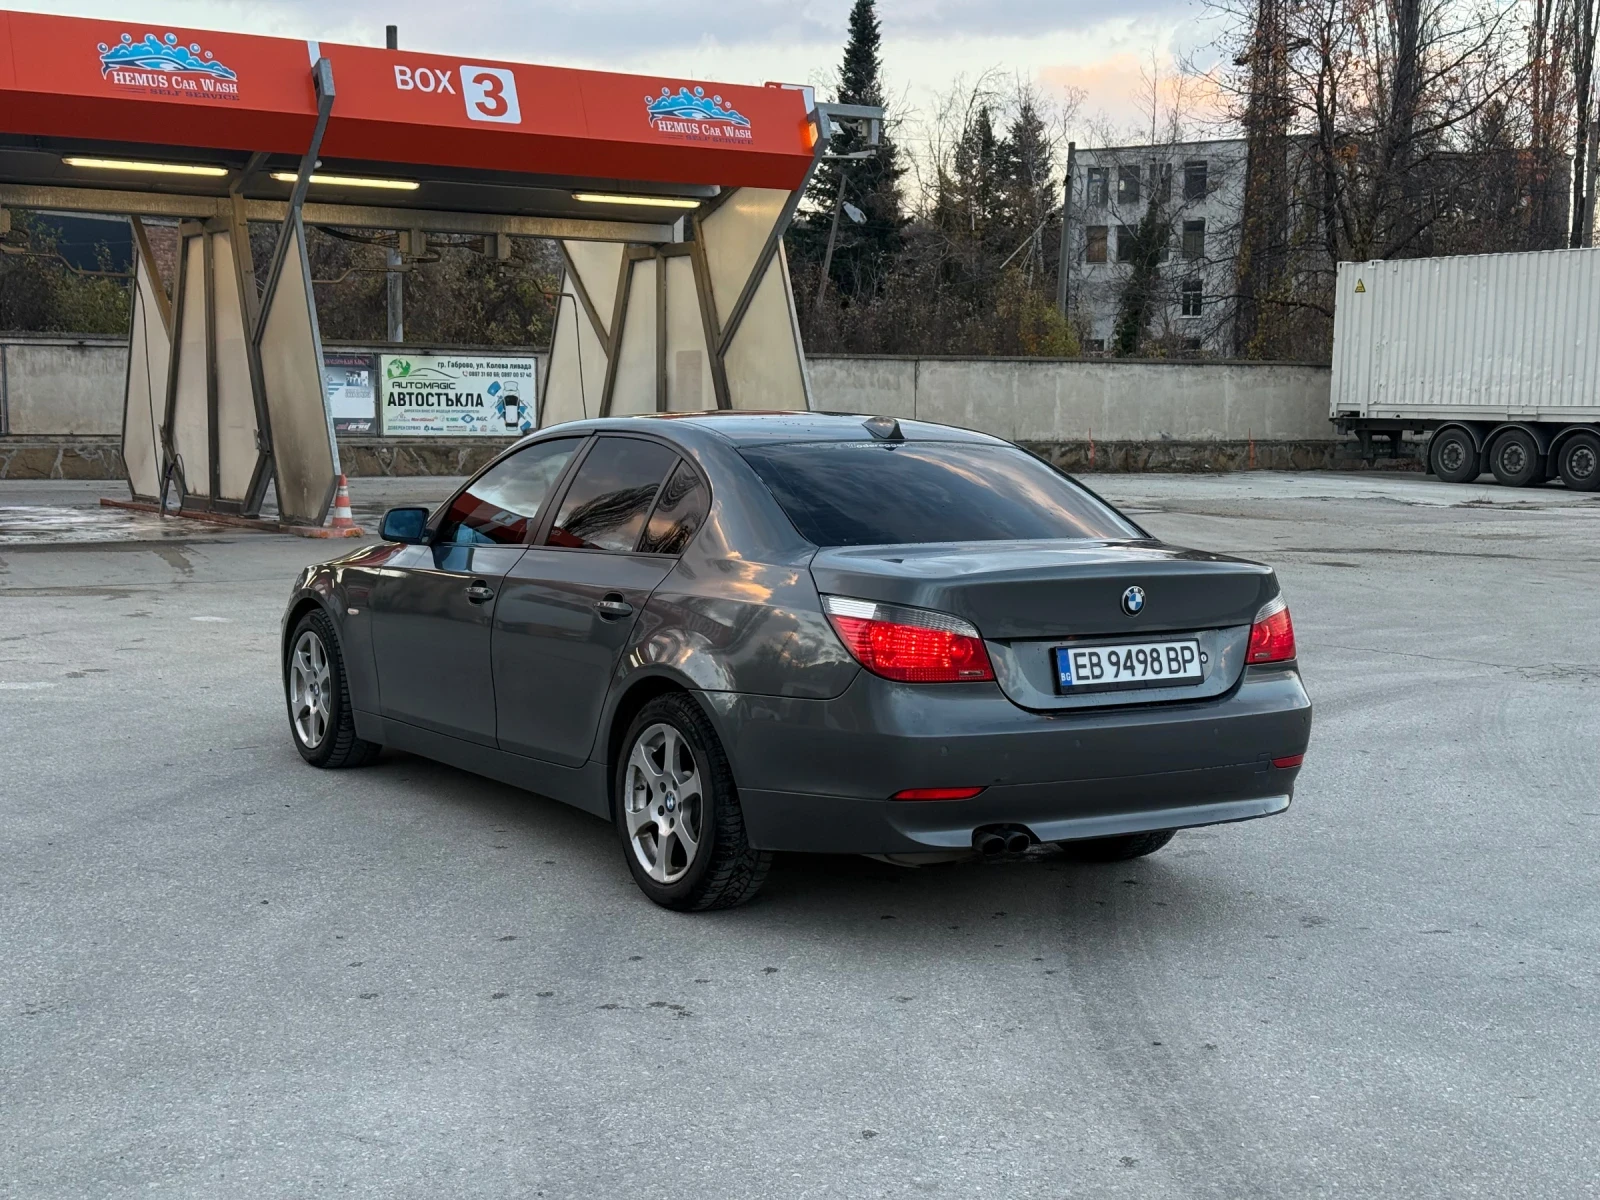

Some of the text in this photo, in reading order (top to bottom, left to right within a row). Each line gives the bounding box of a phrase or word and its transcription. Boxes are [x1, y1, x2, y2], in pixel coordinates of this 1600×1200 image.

[112, 71, 168, 88] HEMUS
[394, 65, 456, 94] BOX
[185, 91, 239, 100] SERVICE
[472, 72, 508, 117] 3
[657, 120, 700, 134] HEMUS
[448, 361, 474, 370] Габрово,
[392, 382, 456, 390] AUTOMAGIC
[388, 392, 484, 407] АВТОСТЪКЛА
[1074, 646, 1194, 680] EB 9498 BP
[1061, 672, 1071, 682] BG
